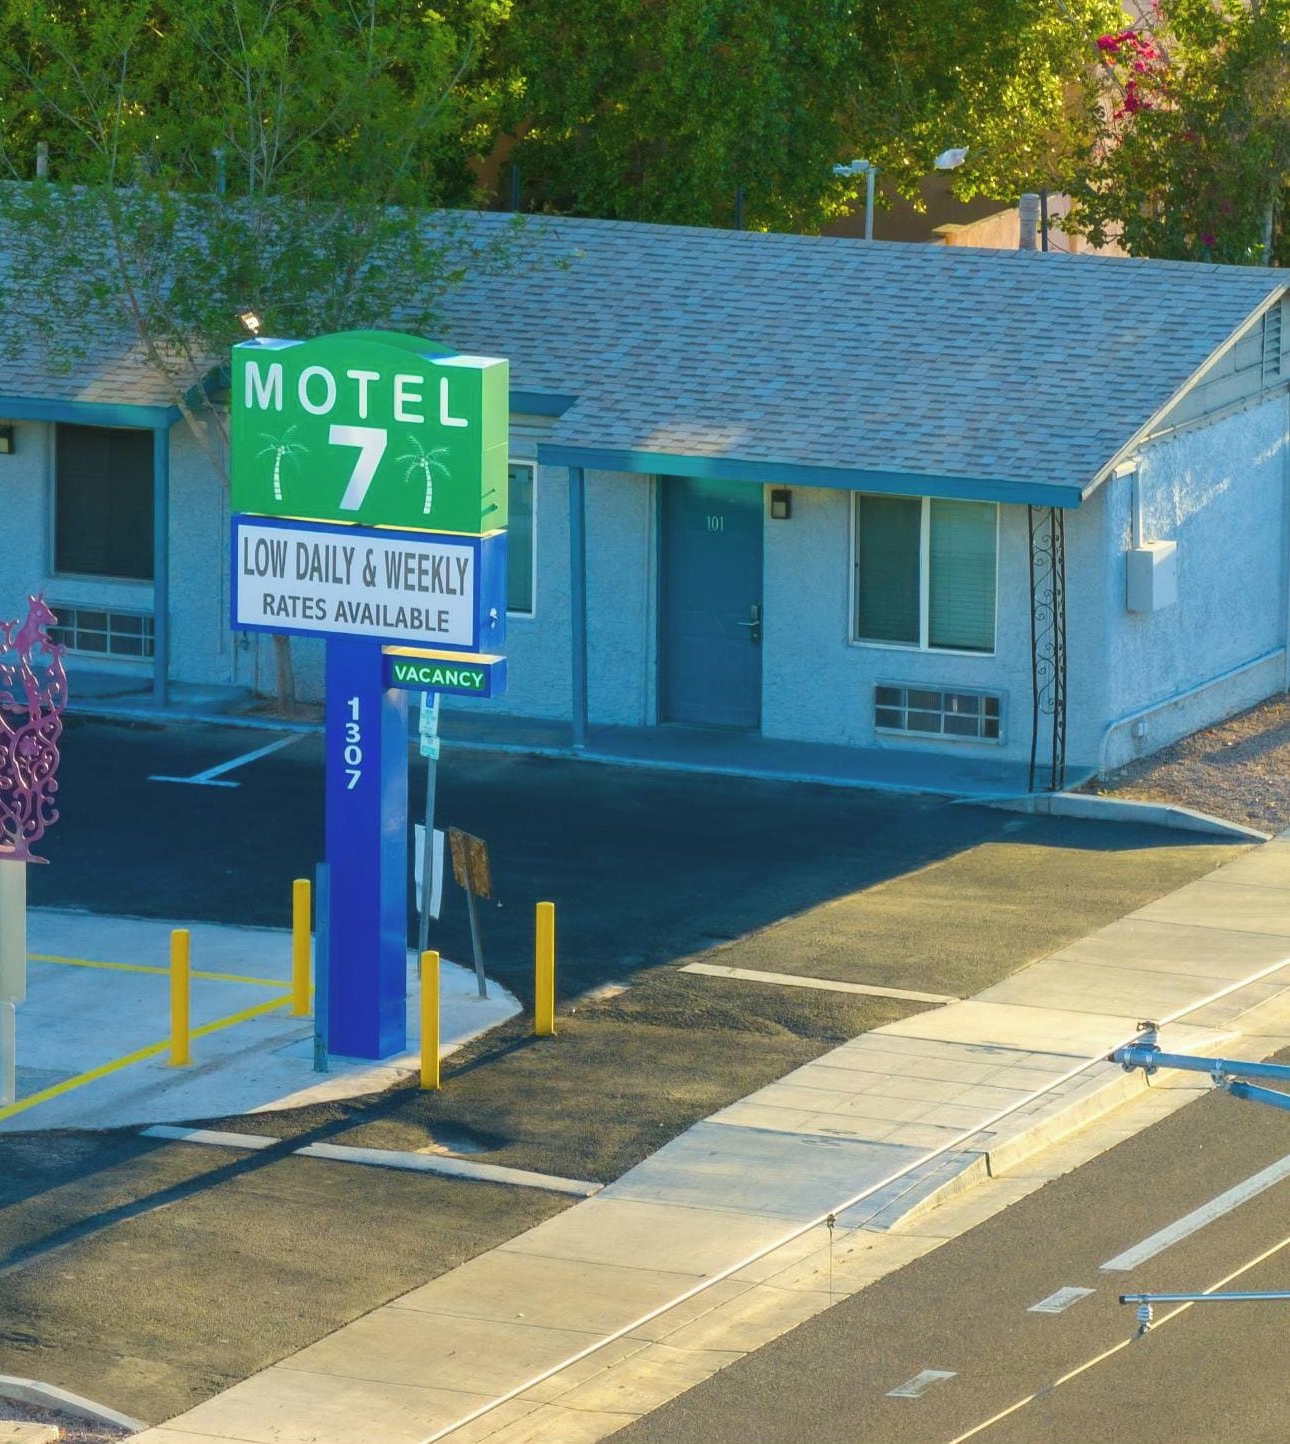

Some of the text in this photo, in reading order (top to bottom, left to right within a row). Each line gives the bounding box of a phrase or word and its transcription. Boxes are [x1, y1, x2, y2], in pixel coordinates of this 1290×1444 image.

[245, 361, 468, 427] MOTEL
[328, 424, 388, 511] 7
[707, 516, 724, 531] 101
[244, 536, 469, 596] LOW DAILY & WEEKLY
[263, 593, 450, 632] RATES AVAILABLE
[395, 664, 483, 688] VACANCY
[343, 697, 363, 790] 1307
